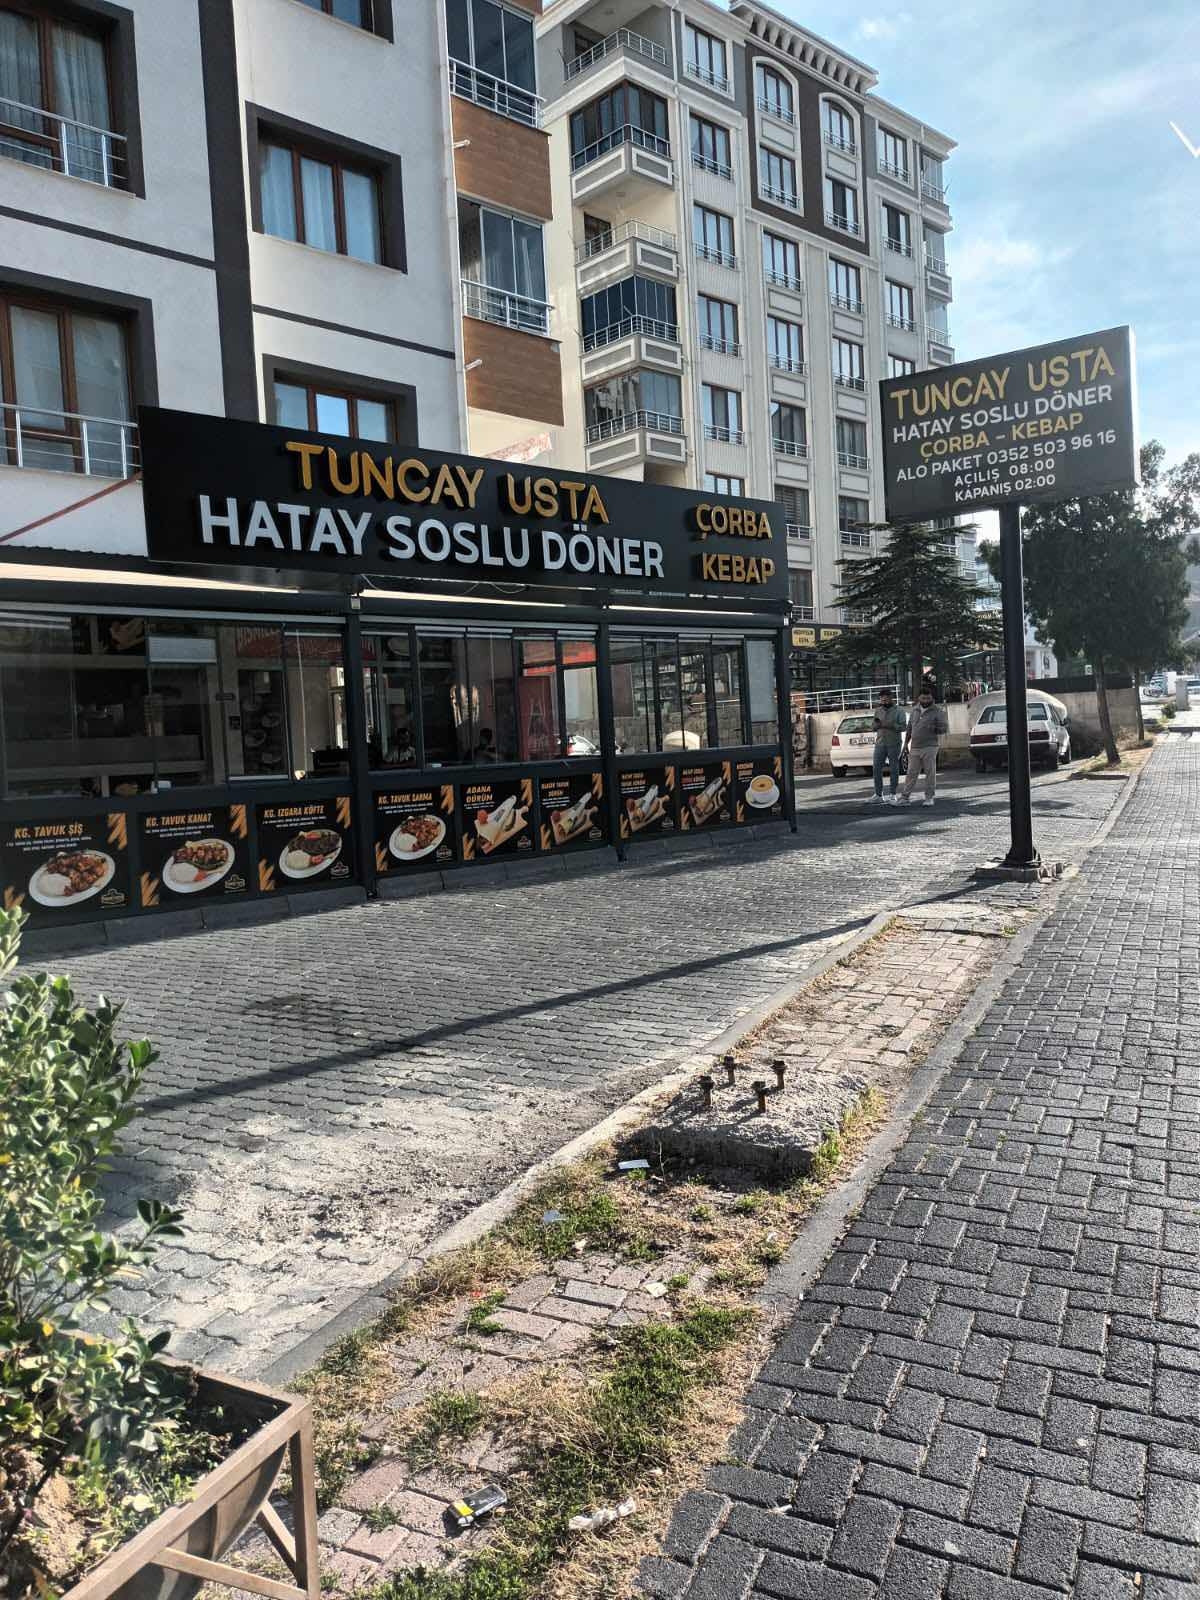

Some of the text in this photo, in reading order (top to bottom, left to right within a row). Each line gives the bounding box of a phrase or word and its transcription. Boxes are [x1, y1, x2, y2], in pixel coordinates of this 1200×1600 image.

[889, 346, 1116, 420] TUNCAY USTA
[893, 384, 1112, 443] HATAY SOSLU DÖNER
[920, 430, 990, 463] ÇORBA
[1011, 412, 1084, 440] KEBAP
[896, 430, 1117, 482] ALO PAKET 0352 503 96 16
[286, 441, 485, 509] TUNCAY
[507, 473, 609, 524] USTA
[954, 458, 1056, 489] AÇILIŞ 08:00
[954, 474, 1056, 502] KAPANIŞ 02:00
[199, 495, 665, 578] HATAY SOSLU DÖNER
[696, 504, 773, 540] ÇORBA
[702, 552, 776, 584] KEBAP
[391, 794, 411, 803] TAVUK
[466, 785, 491, 794] ADANA
[145, 813, 212, 827] KG. TAVUK KANAT
[277, 807, 302, 817] IZGARA
[14, 828, 31, 839] KG.
[34, 825, 66, 838] TAVUK
